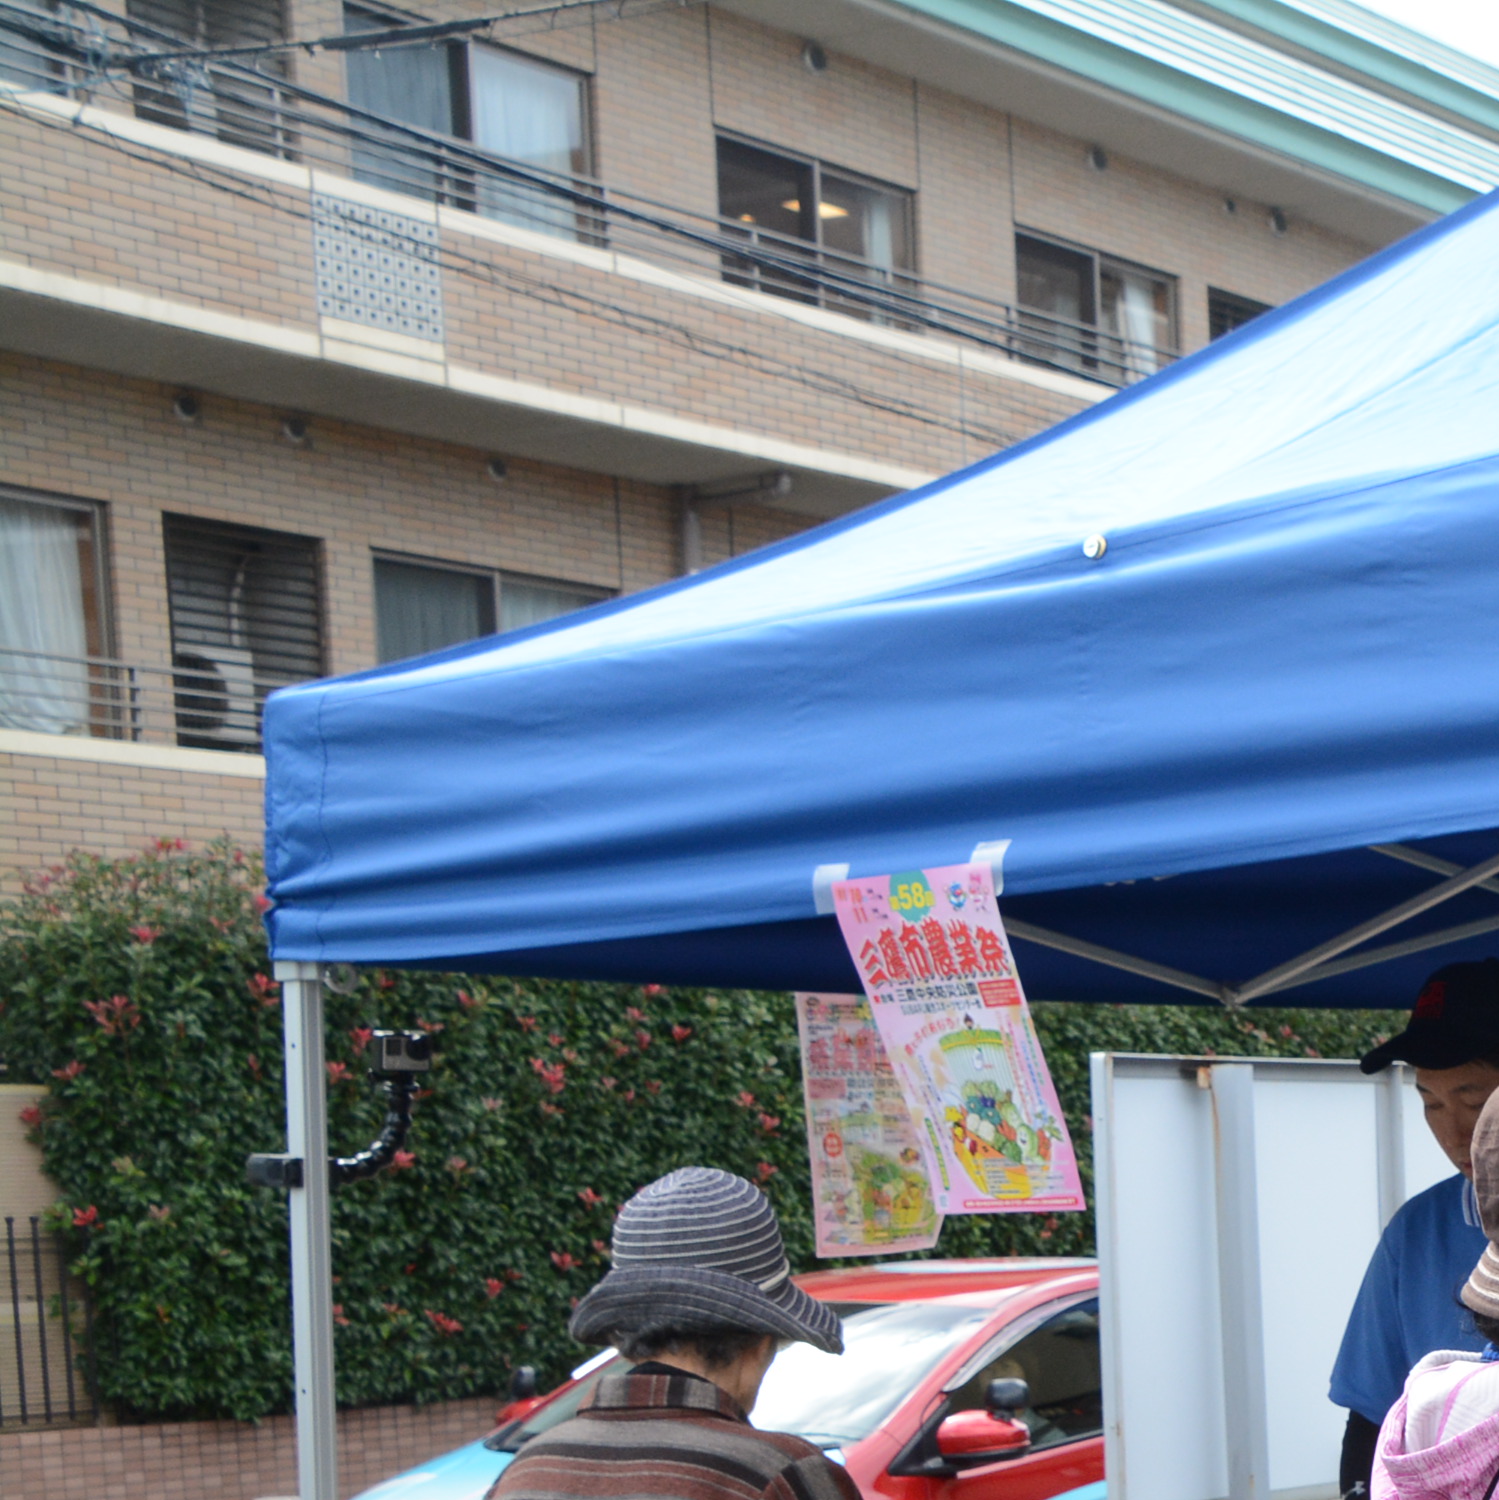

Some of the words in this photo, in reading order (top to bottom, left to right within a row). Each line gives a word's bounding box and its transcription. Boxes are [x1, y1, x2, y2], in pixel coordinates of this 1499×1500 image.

[860, 917, 1009, 986] 三鷹市農業祭
